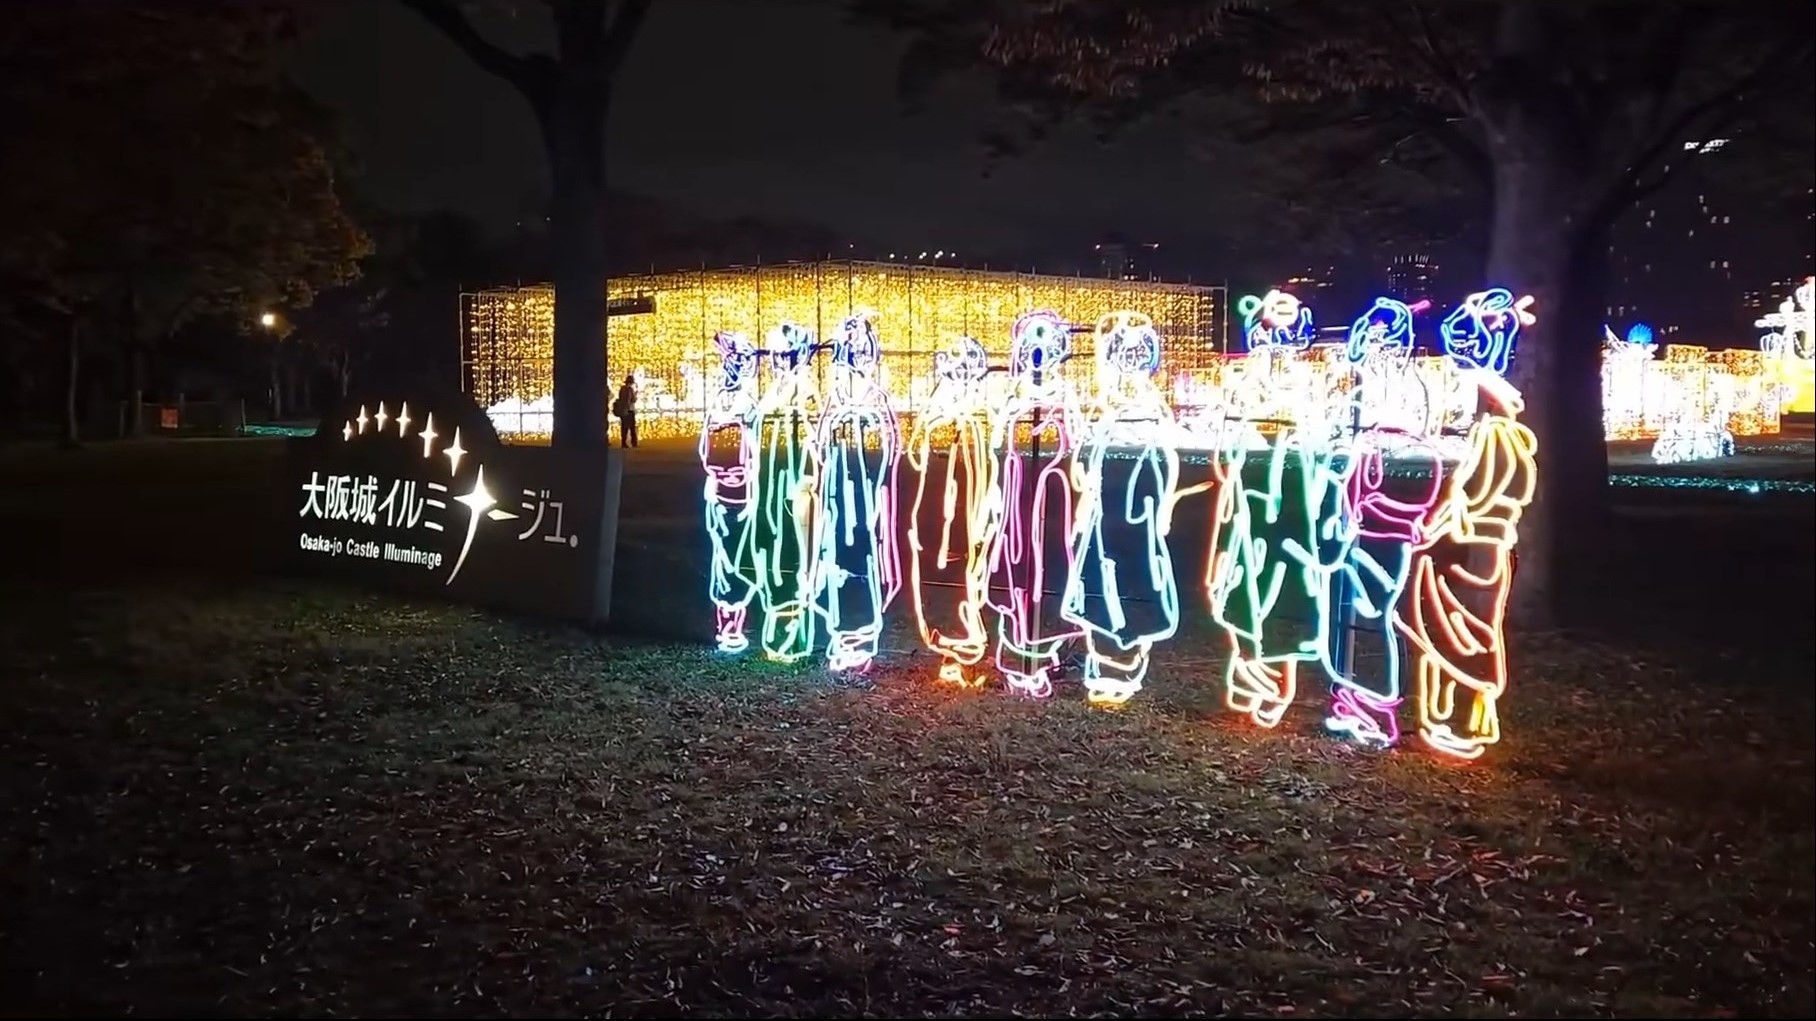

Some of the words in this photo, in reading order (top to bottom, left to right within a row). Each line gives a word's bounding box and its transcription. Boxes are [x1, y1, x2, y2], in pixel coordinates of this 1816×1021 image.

[300, 533, 342, 556] Osaka-jo
[346, 539, 380, 559] Castle
[384, 543, 442, 570] Illuminage
